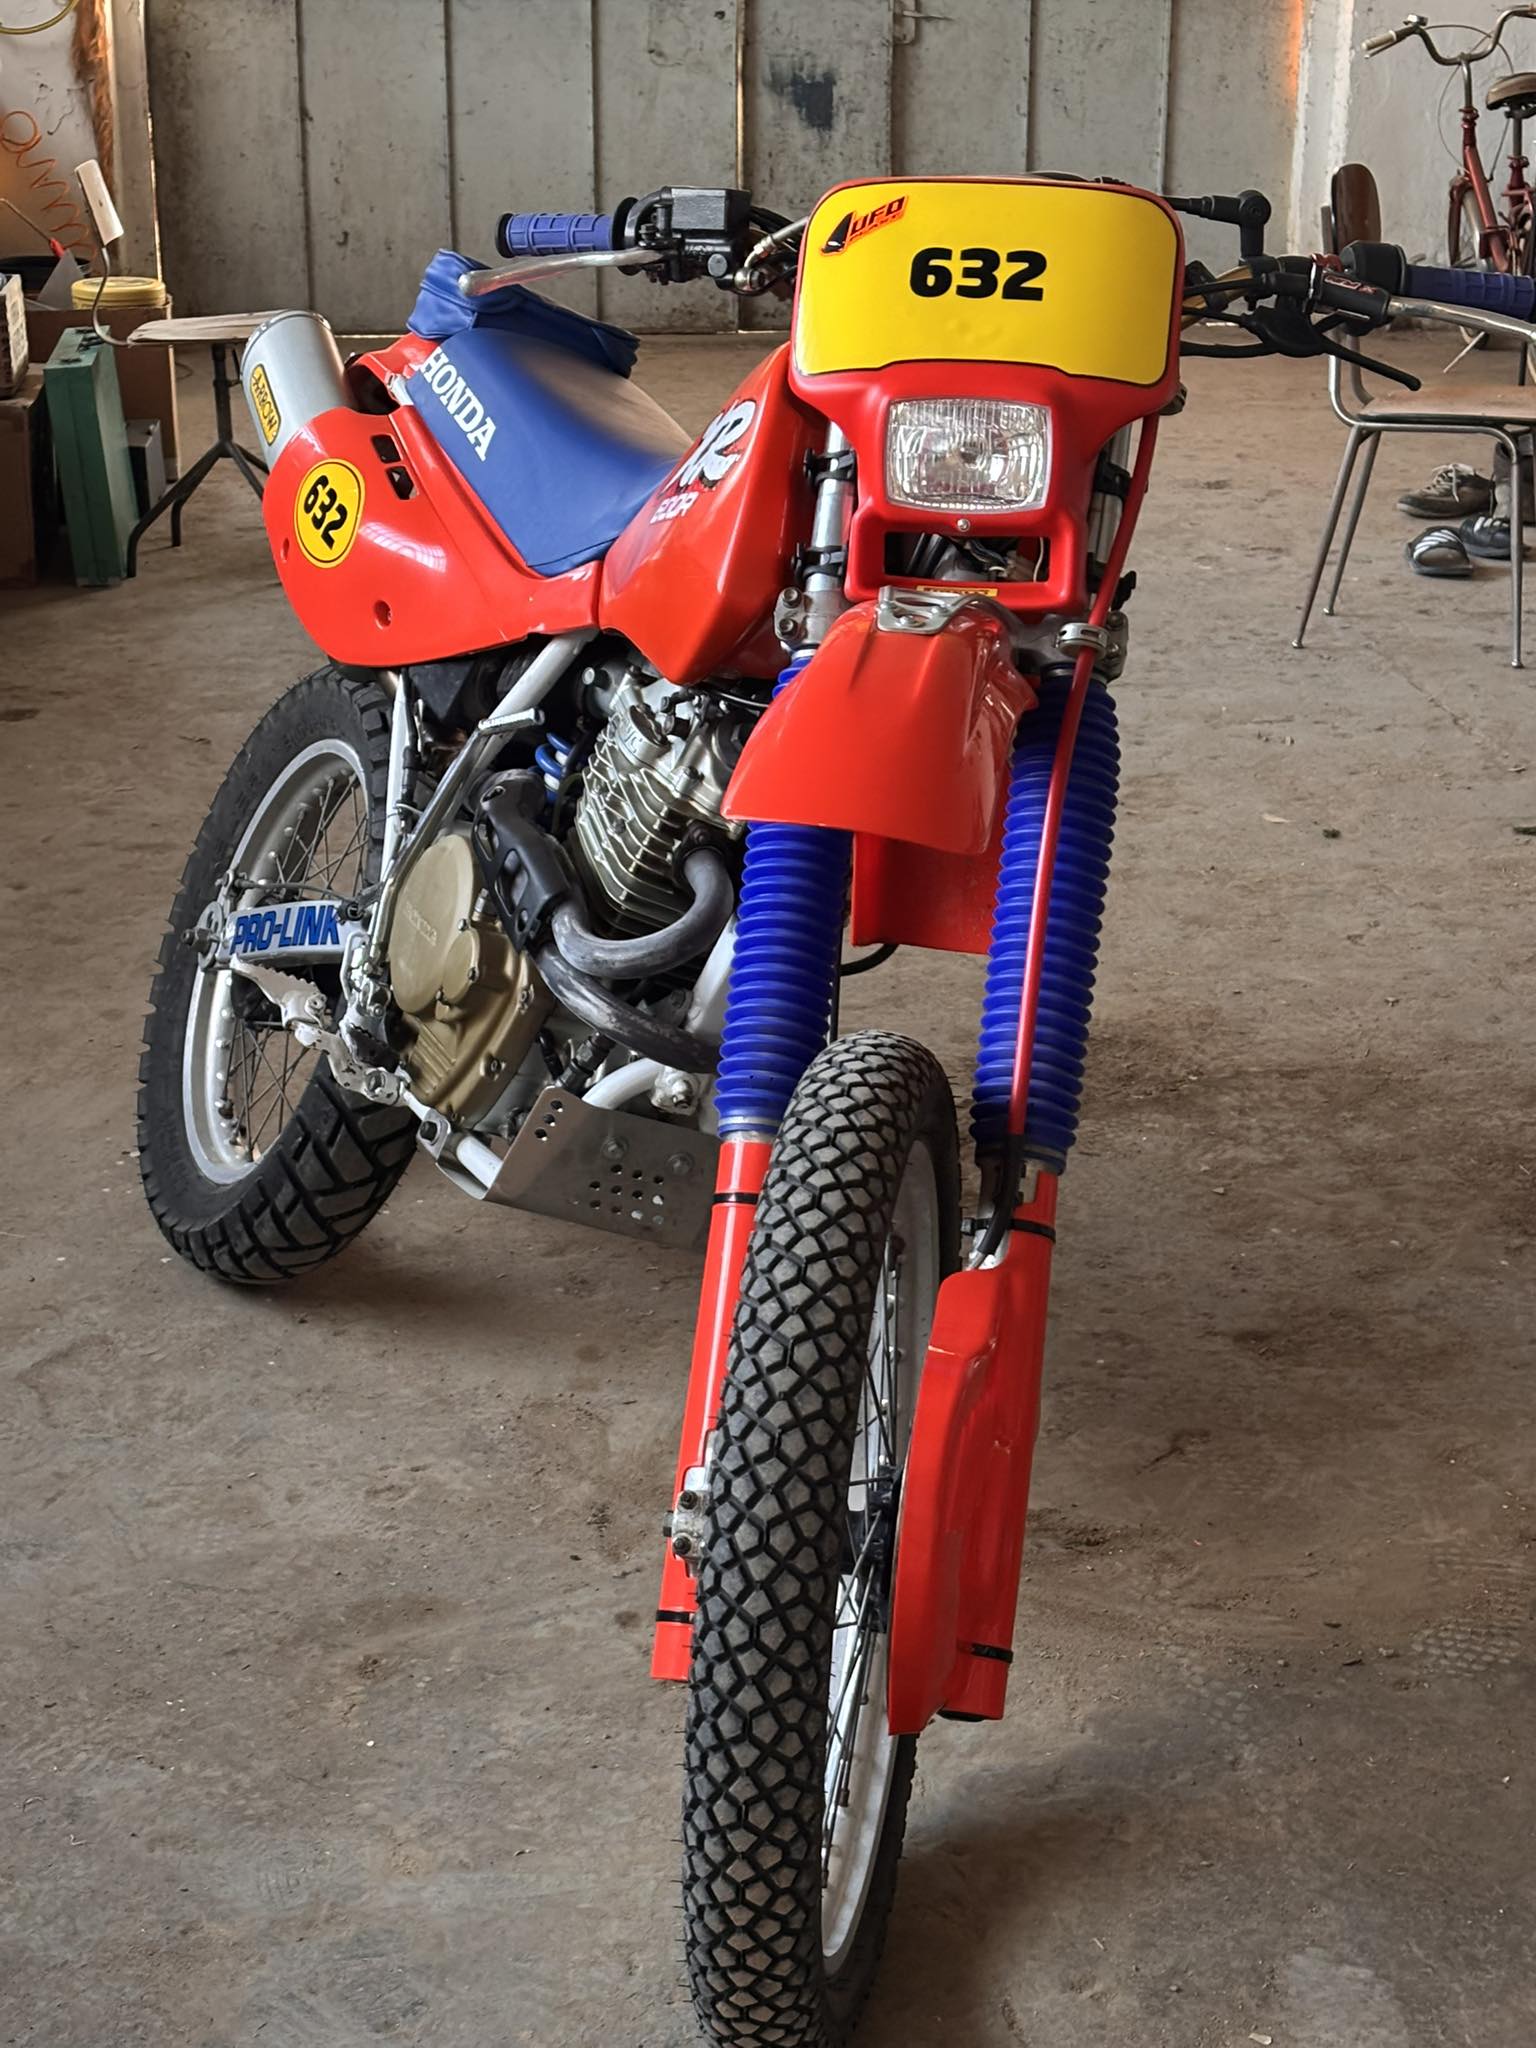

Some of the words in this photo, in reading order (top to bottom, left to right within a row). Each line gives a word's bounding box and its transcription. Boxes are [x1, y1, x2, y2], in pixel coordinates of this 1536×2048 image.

[849, 195, 906, 237] UFO
[909, 246, 1048, 302] 632
[251, 372, 278, 432] ARROW
[419, 345, 497, 462] HONDA
[303, 474, 348, 551] 632
[229, 904, 340, 955] PRO-LINK
